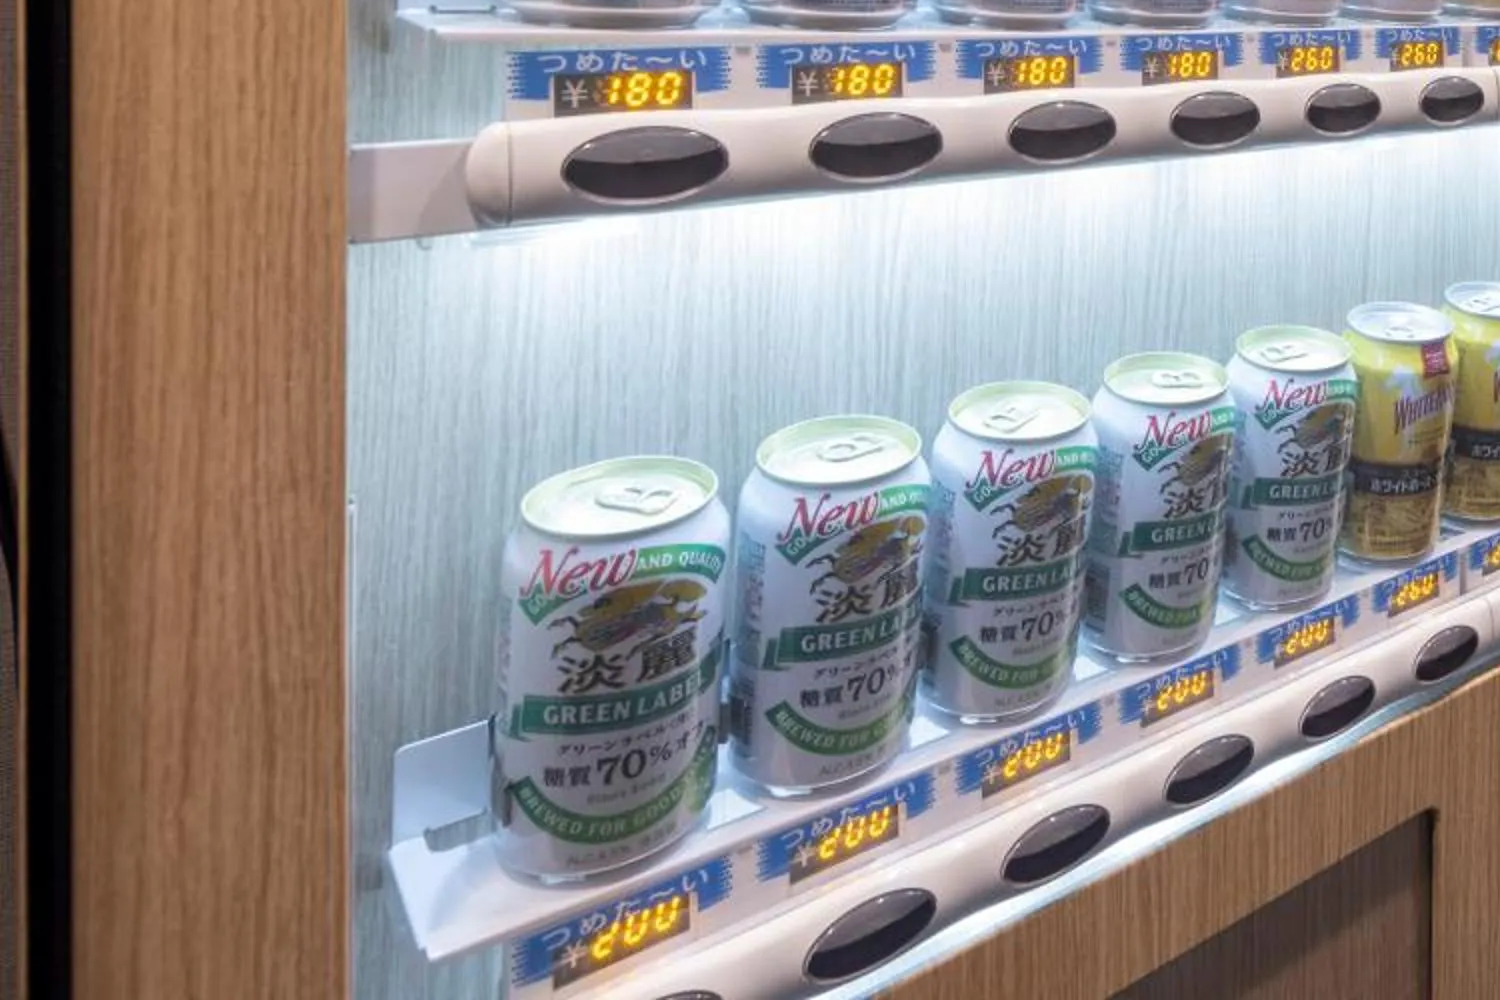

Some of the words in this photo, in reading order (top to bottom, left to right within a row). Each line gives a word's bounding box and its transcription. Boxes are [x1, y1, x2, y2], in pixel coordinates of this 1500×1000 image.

[1255, 377, 1326, 411] New
[1133, 409, 1211, 451] New
[966, 448, 1055, 488] New
[1268, 483, 1320, 499] GREEN
[776, 492, 880, 542] New
[1151, 524, 1207, 543] GREEN
[519, 546, 637, 597] New
[637, 553, 673, 571] AND
[982, 572, 1048, 592] GREEN
[801, 624, 876, 653] GREEN
[543, 700, 630, 725] GREEN
[637, 672, 704, 714] LABEL
[775, 711, 834, 747] BREWED
[518, 785, 582, 835] BREWED
[588, 820, 625, 836] FOR
[634, 788, 684, 827] GOOD
